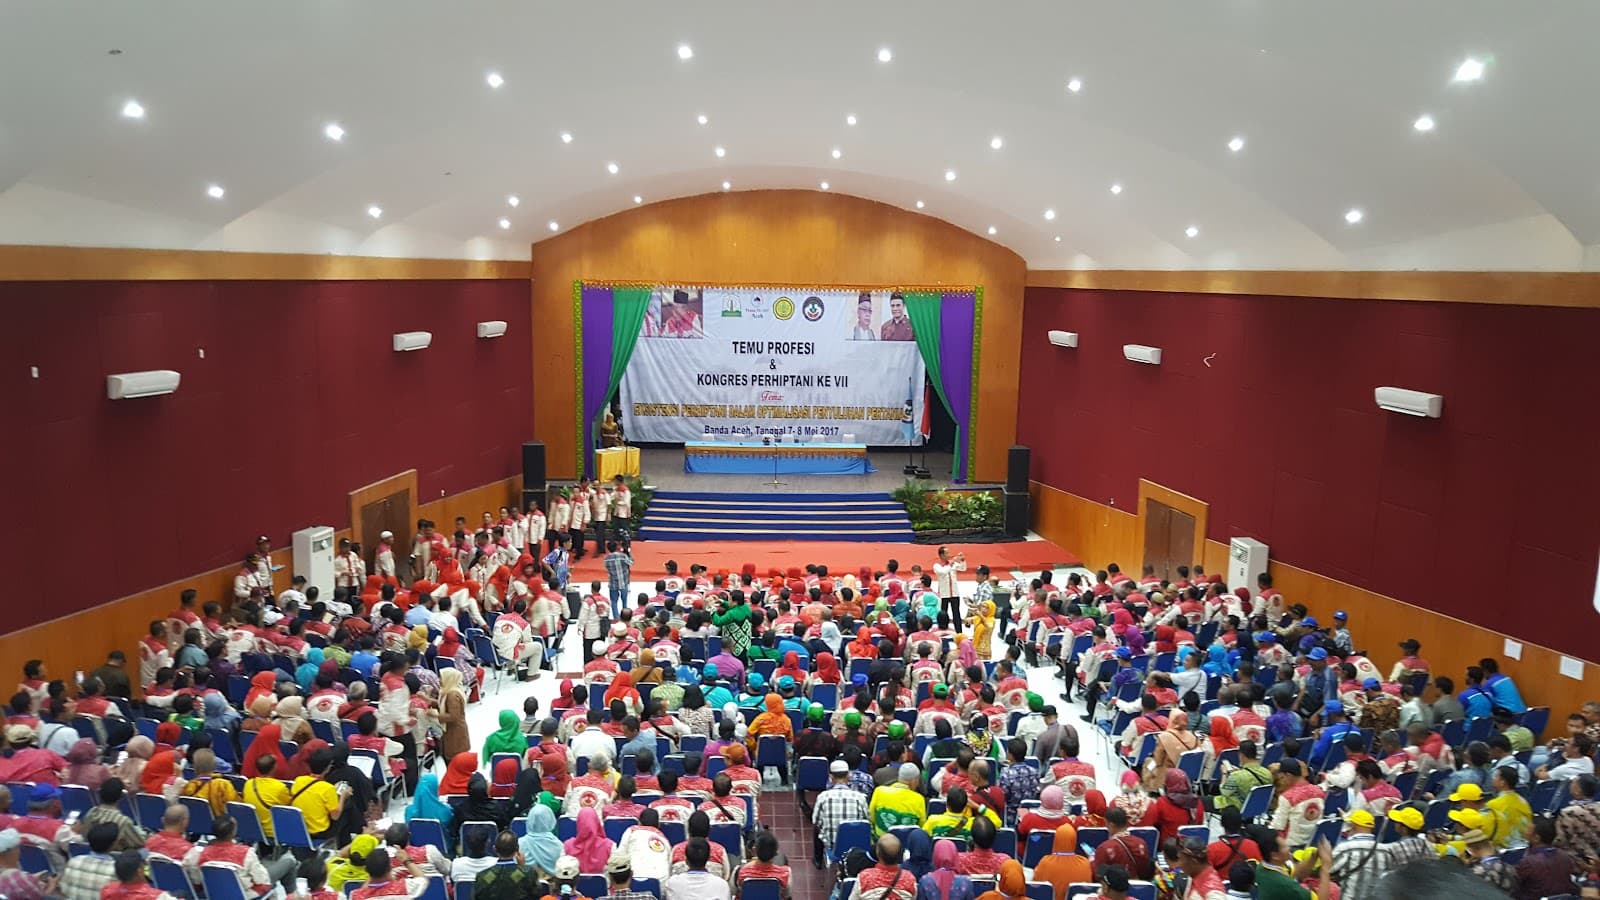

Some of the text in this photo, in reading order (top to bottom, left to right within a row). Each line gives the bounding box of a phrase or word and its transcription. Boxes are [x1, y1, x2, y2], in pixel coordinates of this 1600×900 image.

[732, 341, 815, 355] TEMU PROFESI
[769, 358, 777, 370] &
[697, 373, 848, 387] KONGRES PERHIPTANI KE VII
[704, 425, 729, 435] Banda
[731, 425, 753, 436] Aceh,
[755, 425, 786, 437] Tanggal
[804, 426, 818, 436] Mei
[820, 426, 840, 436] 2017
